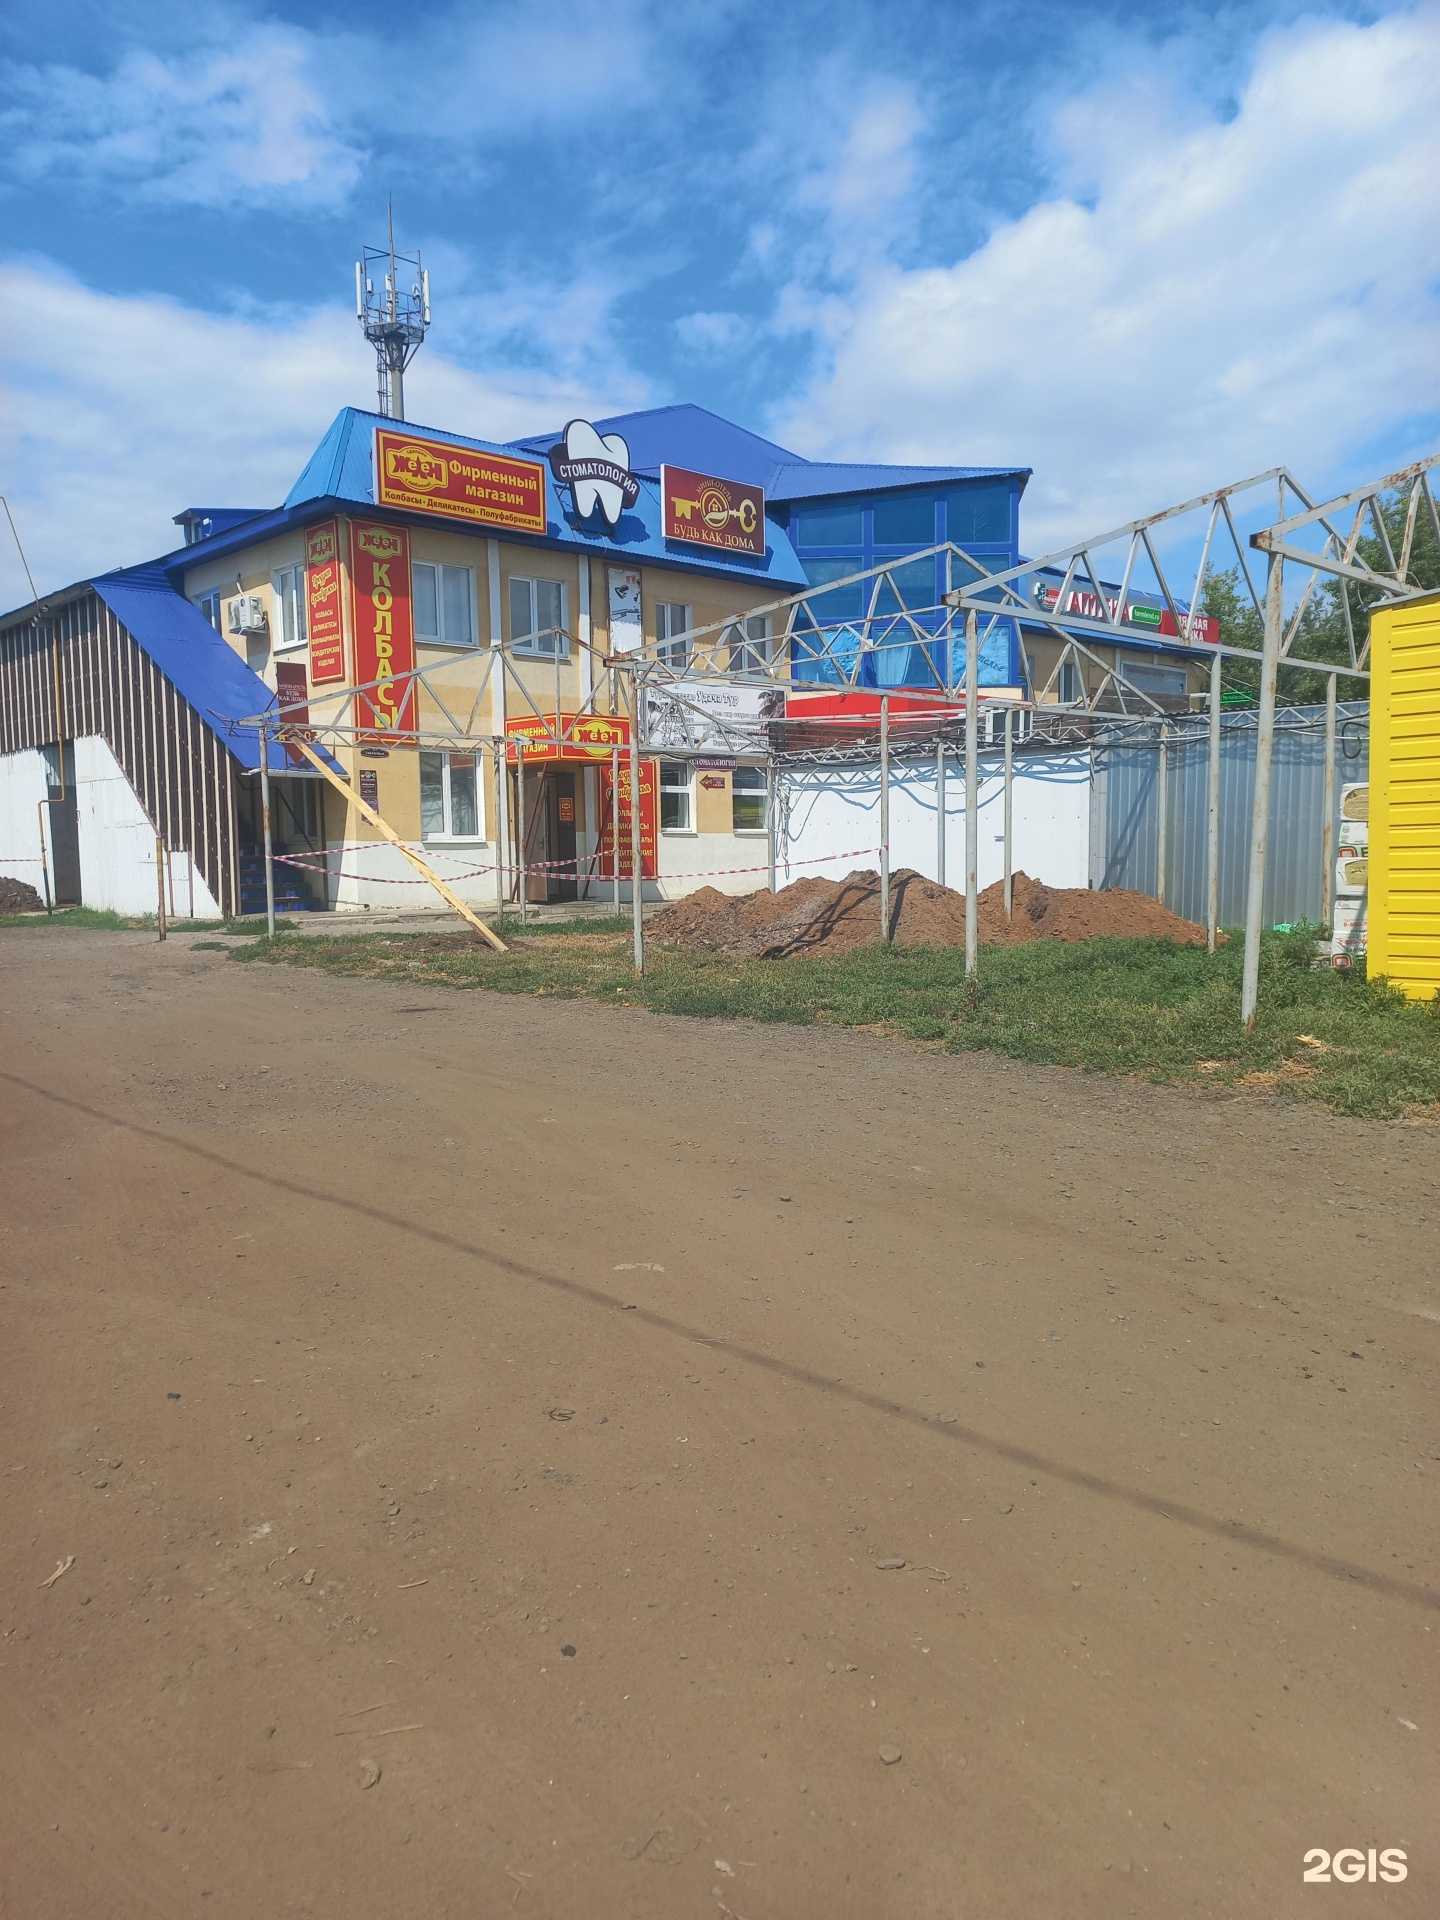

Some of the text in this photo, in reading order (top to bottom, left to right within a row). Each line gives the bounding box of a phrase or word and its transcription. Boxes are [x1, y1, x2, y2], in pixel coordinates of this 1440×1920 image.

[450, 459, 537, 491] Фирменный
[559, 462, 638, 495] СТОМАТОЛОГИЯ
[384, 490, 542, 528] Колбасы Деликатесы Полуфабрикаты
[465, 485, 524, 506] магазин
[673, 523, 755, 550] БУДЬ КАК ДОМА
[371, 561, 398, 729] КОЛБАСЫ
